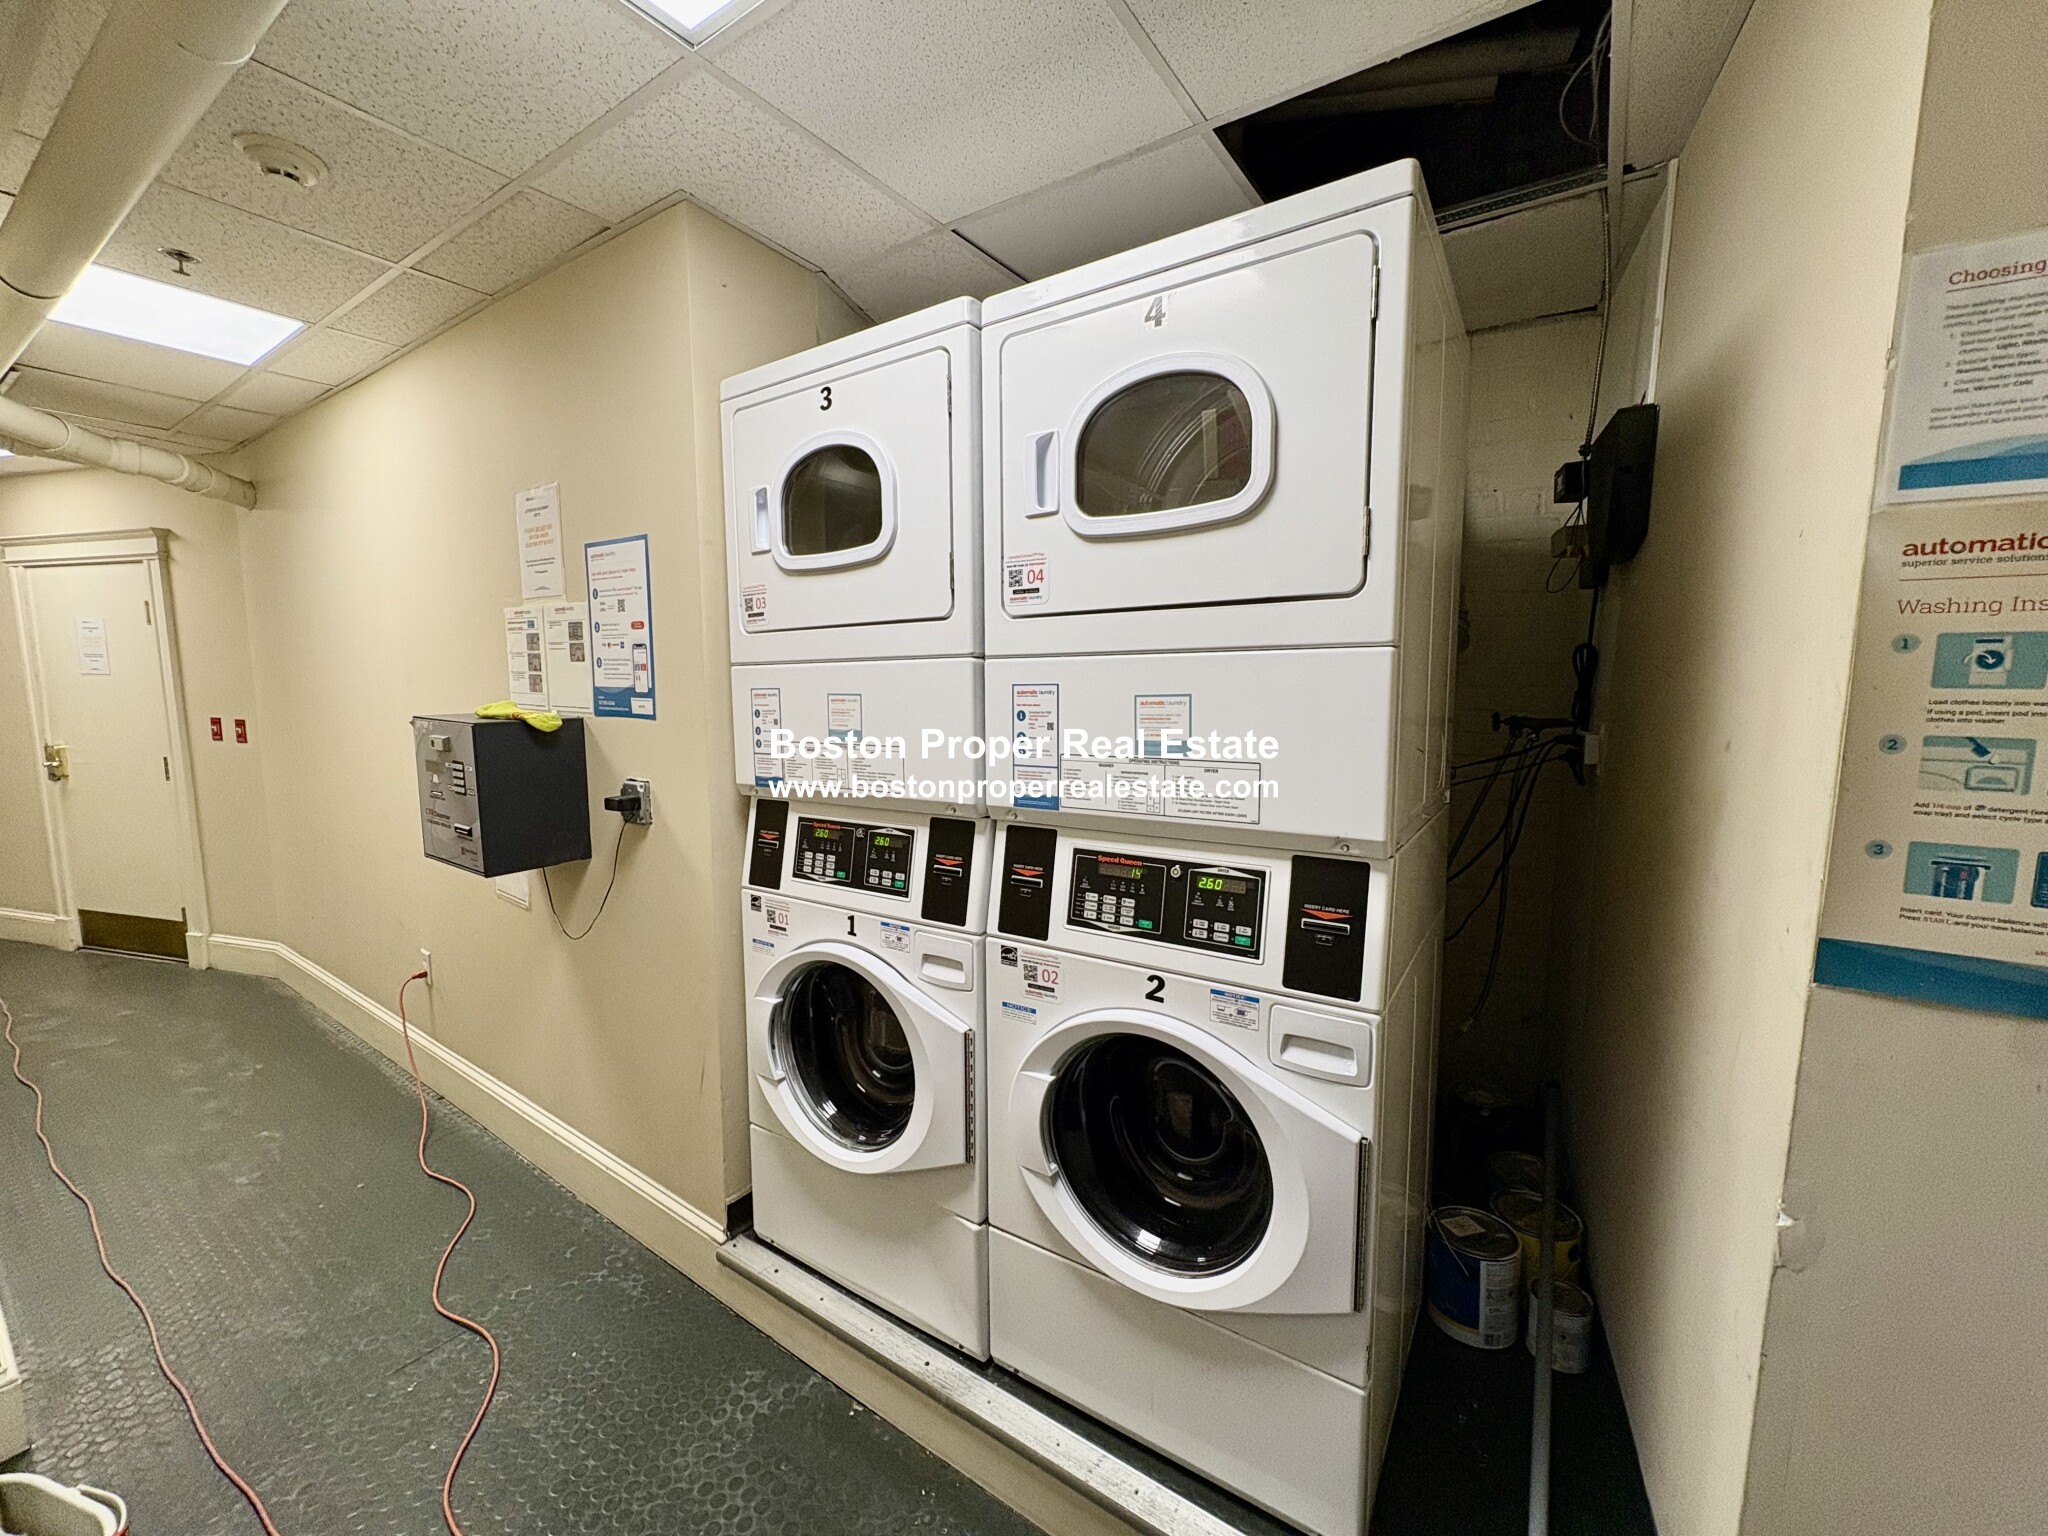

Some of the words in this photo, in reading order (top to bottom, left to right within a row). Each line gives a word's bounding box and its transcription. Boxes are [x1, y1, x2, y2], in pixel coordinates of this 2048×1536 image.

[1949, 259, 2047, 285] Choosing
[1144, 296, 1166, 327] 4
[820, 387, 832, 411] 3
[1902, 533, 2048, 557] automatic
[1901, 558, 1947, 568] superior
[1951, 556, 1993, 565] service
[1028, 569, 1044, 584] 04
[756, 598, 766, 609] 03
[1898, 597, 2002, 616] Washing
[1902, 639, 1909, 650] 1
[1887, 740, 1898, 751] 2
[1988, 807, 2028, 815] detergent
[1873, 844, 1884, 855] 3
[1098, 855, 1119, 864] Speed
[1120, 857, 1142, 867] Queen
[1199, 877, 1222, 890] 2.60
[778, 913, 789, 925] 01
[847, 915, 857, 936] 1
[1966, 914, 1996, 922] current
[1998, 918, 2031, 927] balance
[2011, 927, 2044, 936] balance
[1042, 969, 1059, 985] 02
[1145, 975, 1165, 1003] 2
